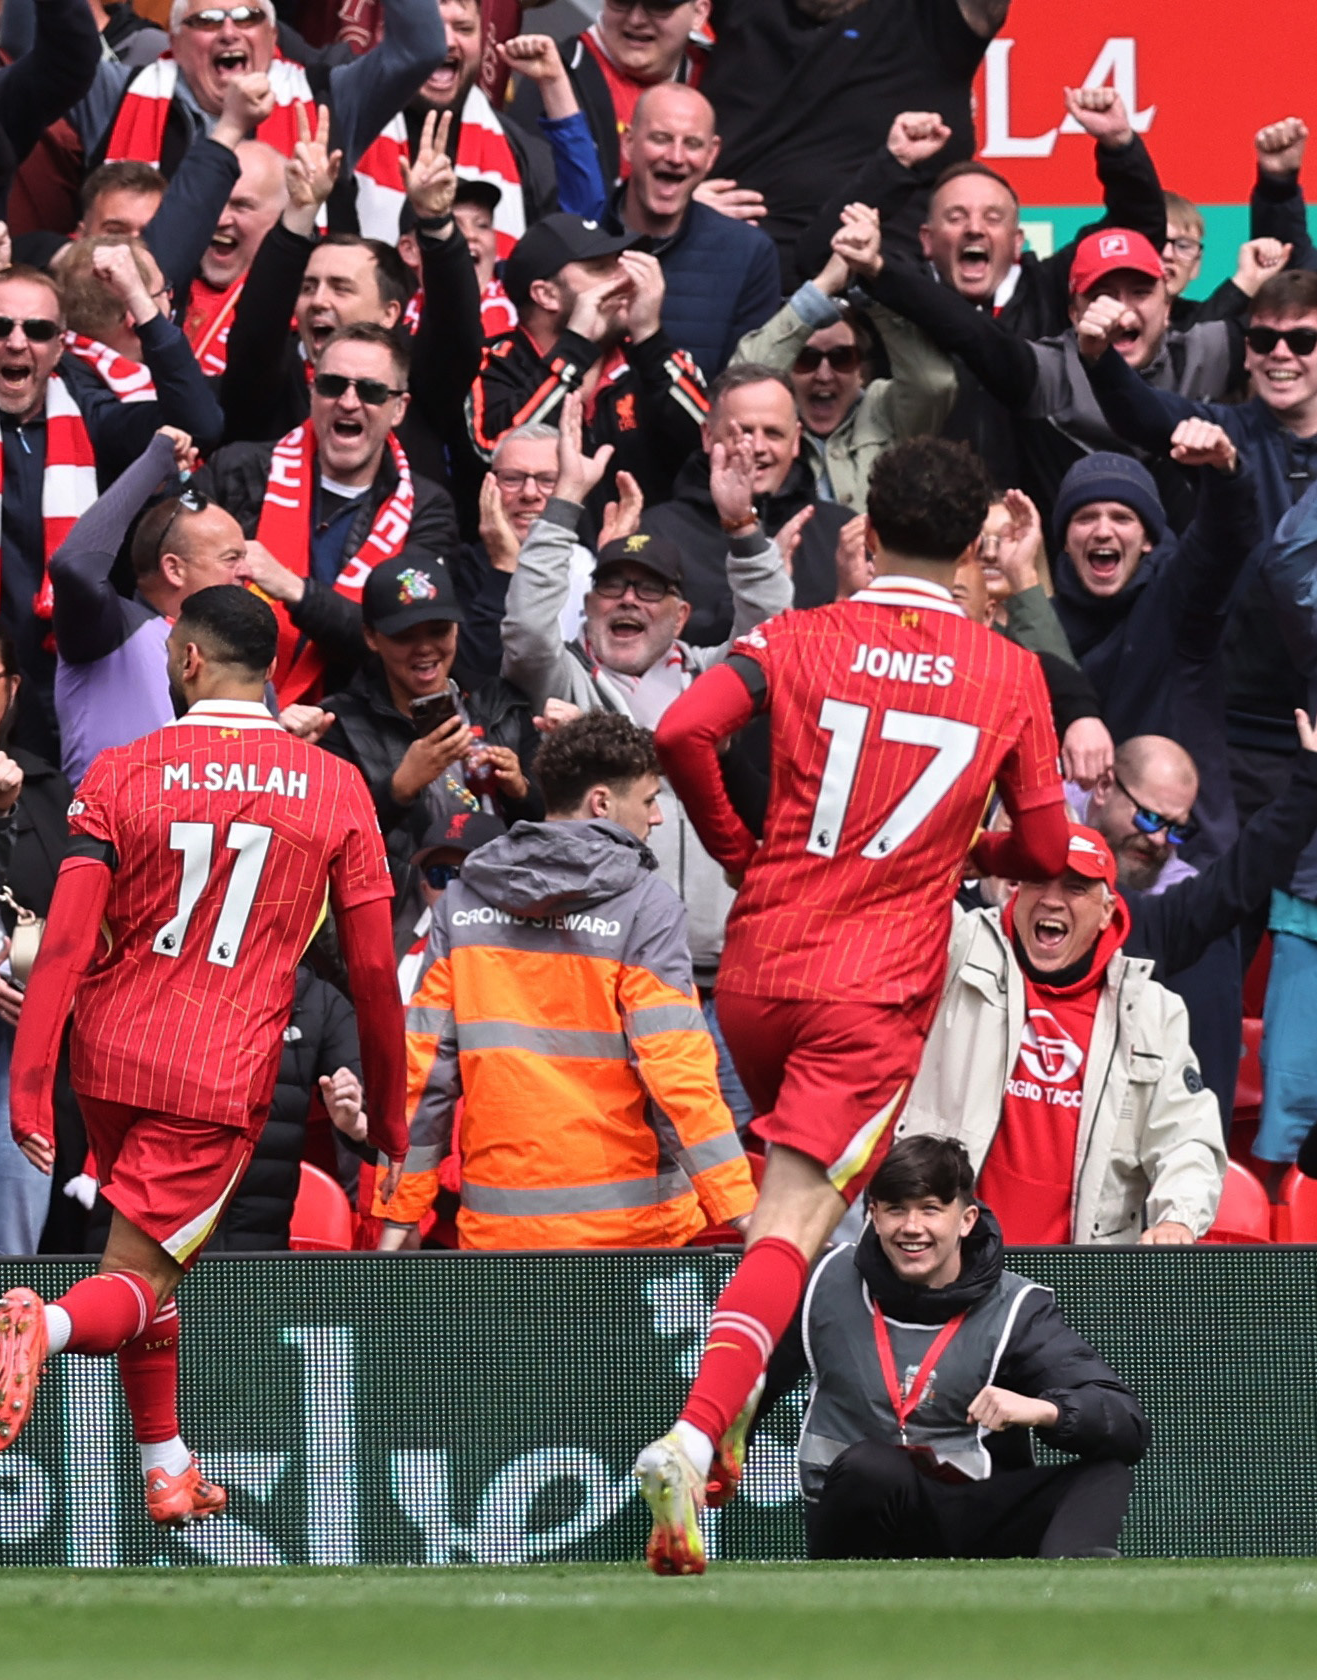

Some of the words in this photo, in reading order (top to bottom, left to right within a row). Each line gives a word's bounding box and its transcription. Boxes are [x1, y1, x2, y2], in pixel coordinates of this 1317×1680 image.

[850, 643, 956, 687] JONES
[163, 762, 308, 800] M.SALAH
[805, 696, 981, 861] 17
[151, 821, 273, 969] 11
[1004, 1078, 1043, 1102] RGIO
